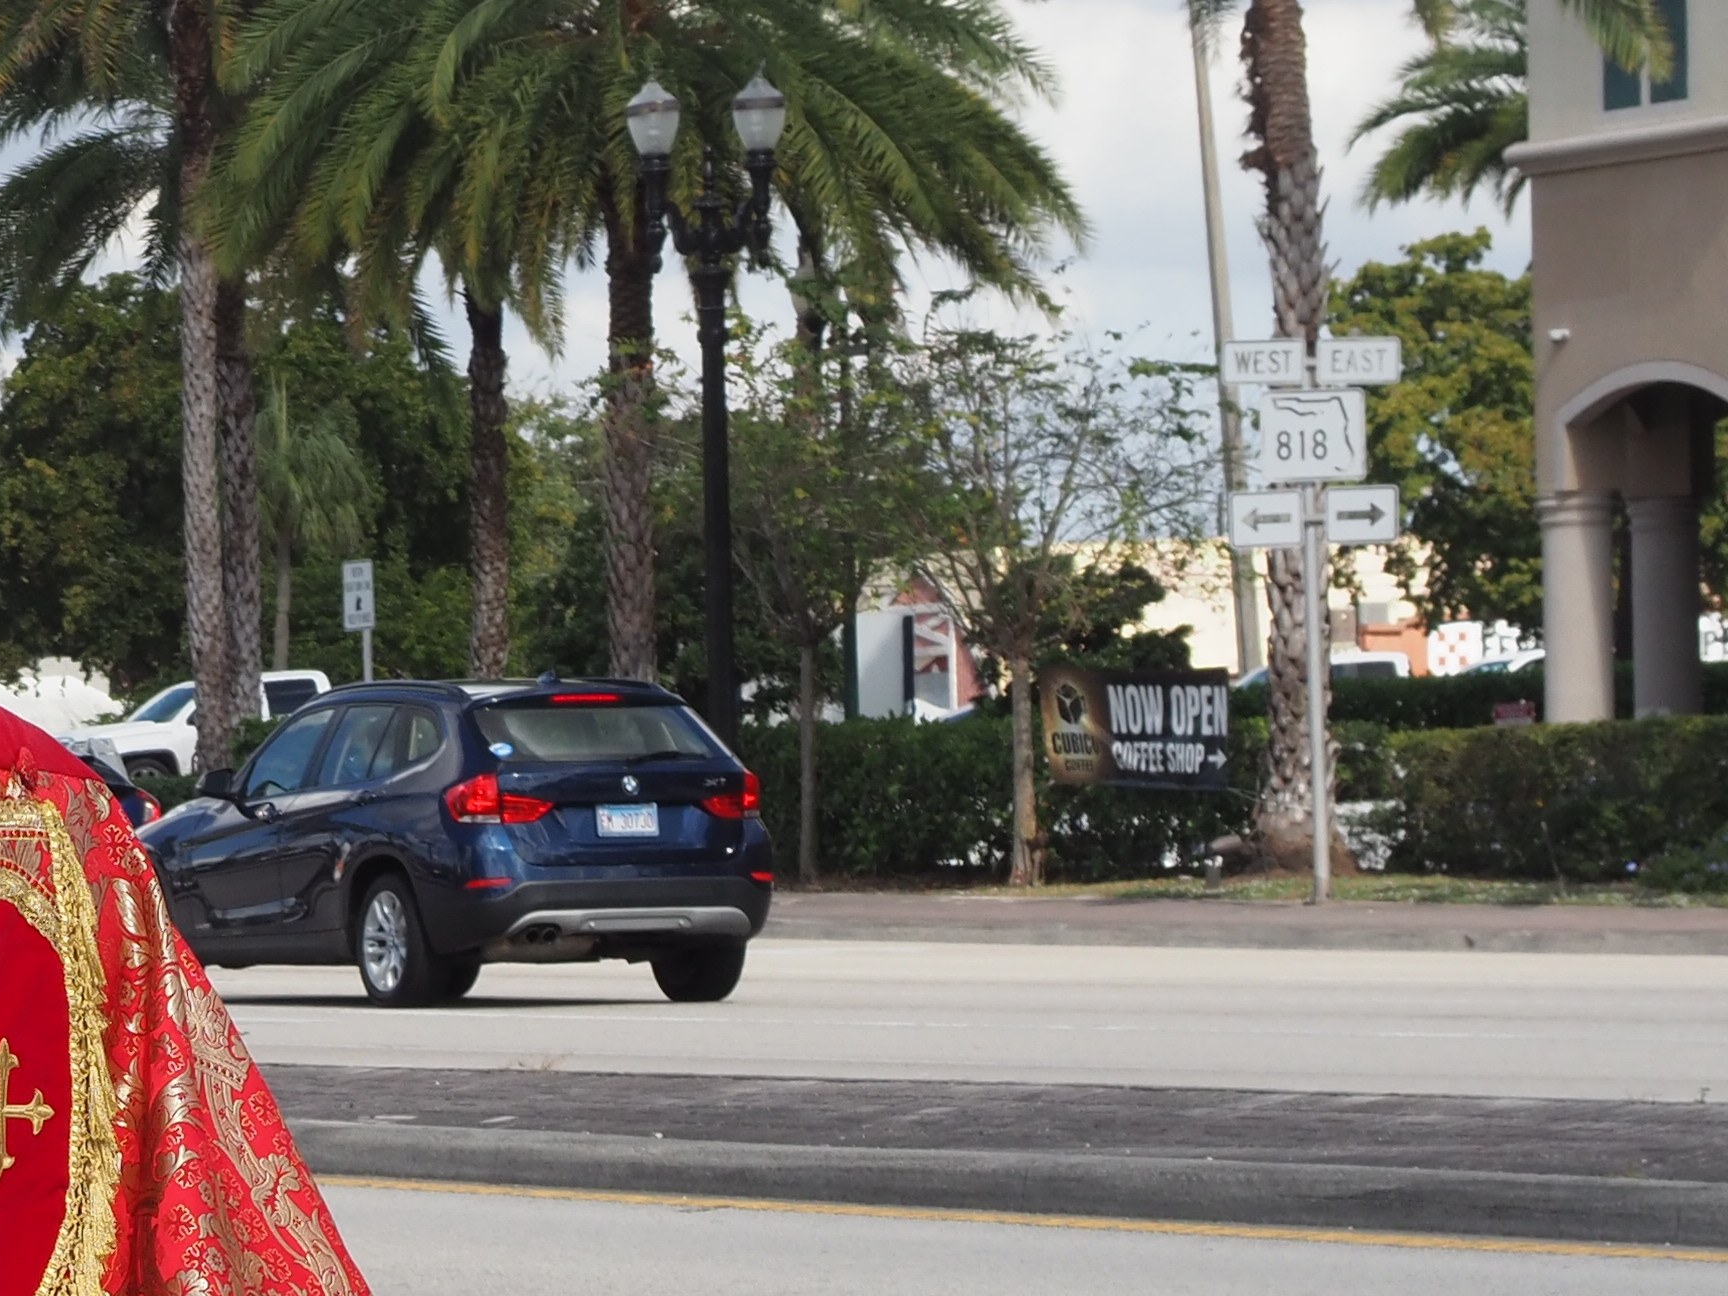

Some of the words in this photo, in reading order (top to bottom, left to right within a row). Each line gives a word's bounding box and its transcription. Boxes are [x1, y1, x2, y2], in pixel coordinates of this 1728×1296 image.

[1234, 350, 1293, 374] WEST
[1330, 349, 1387, 373] EAST
[1276, 429, 1328, 461] 818
[1106, 684, 1164, 735] NOW
[1169, 684, 1229, 737] OPEN
[1111, 740, 1165, 773] COFFEE
[1166, 741, 1206, 775] SHOP
